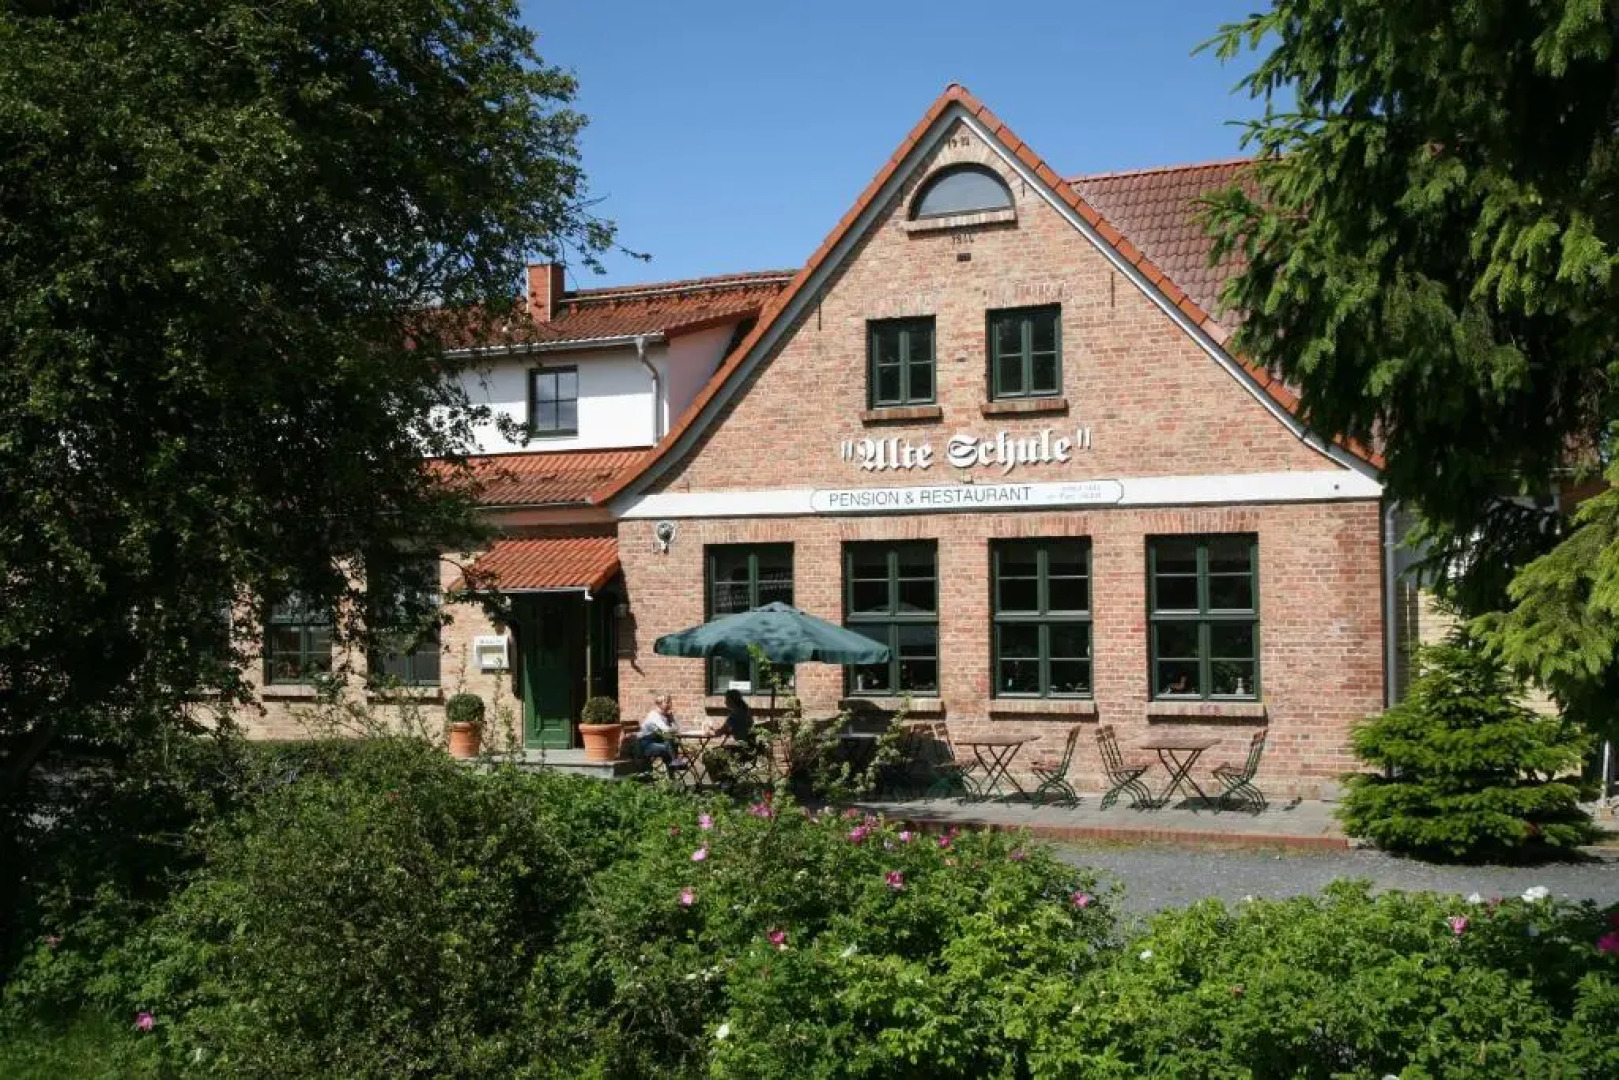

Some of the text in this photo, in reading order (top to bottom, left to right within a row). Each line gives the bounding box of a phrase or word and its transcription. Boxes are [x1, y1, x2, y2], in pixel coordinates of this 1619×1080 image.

[828, 489, 900, 508] PENSION
[904, 490, 915, 505] &
[919, 486, 1032, 505] RESTAURANT
